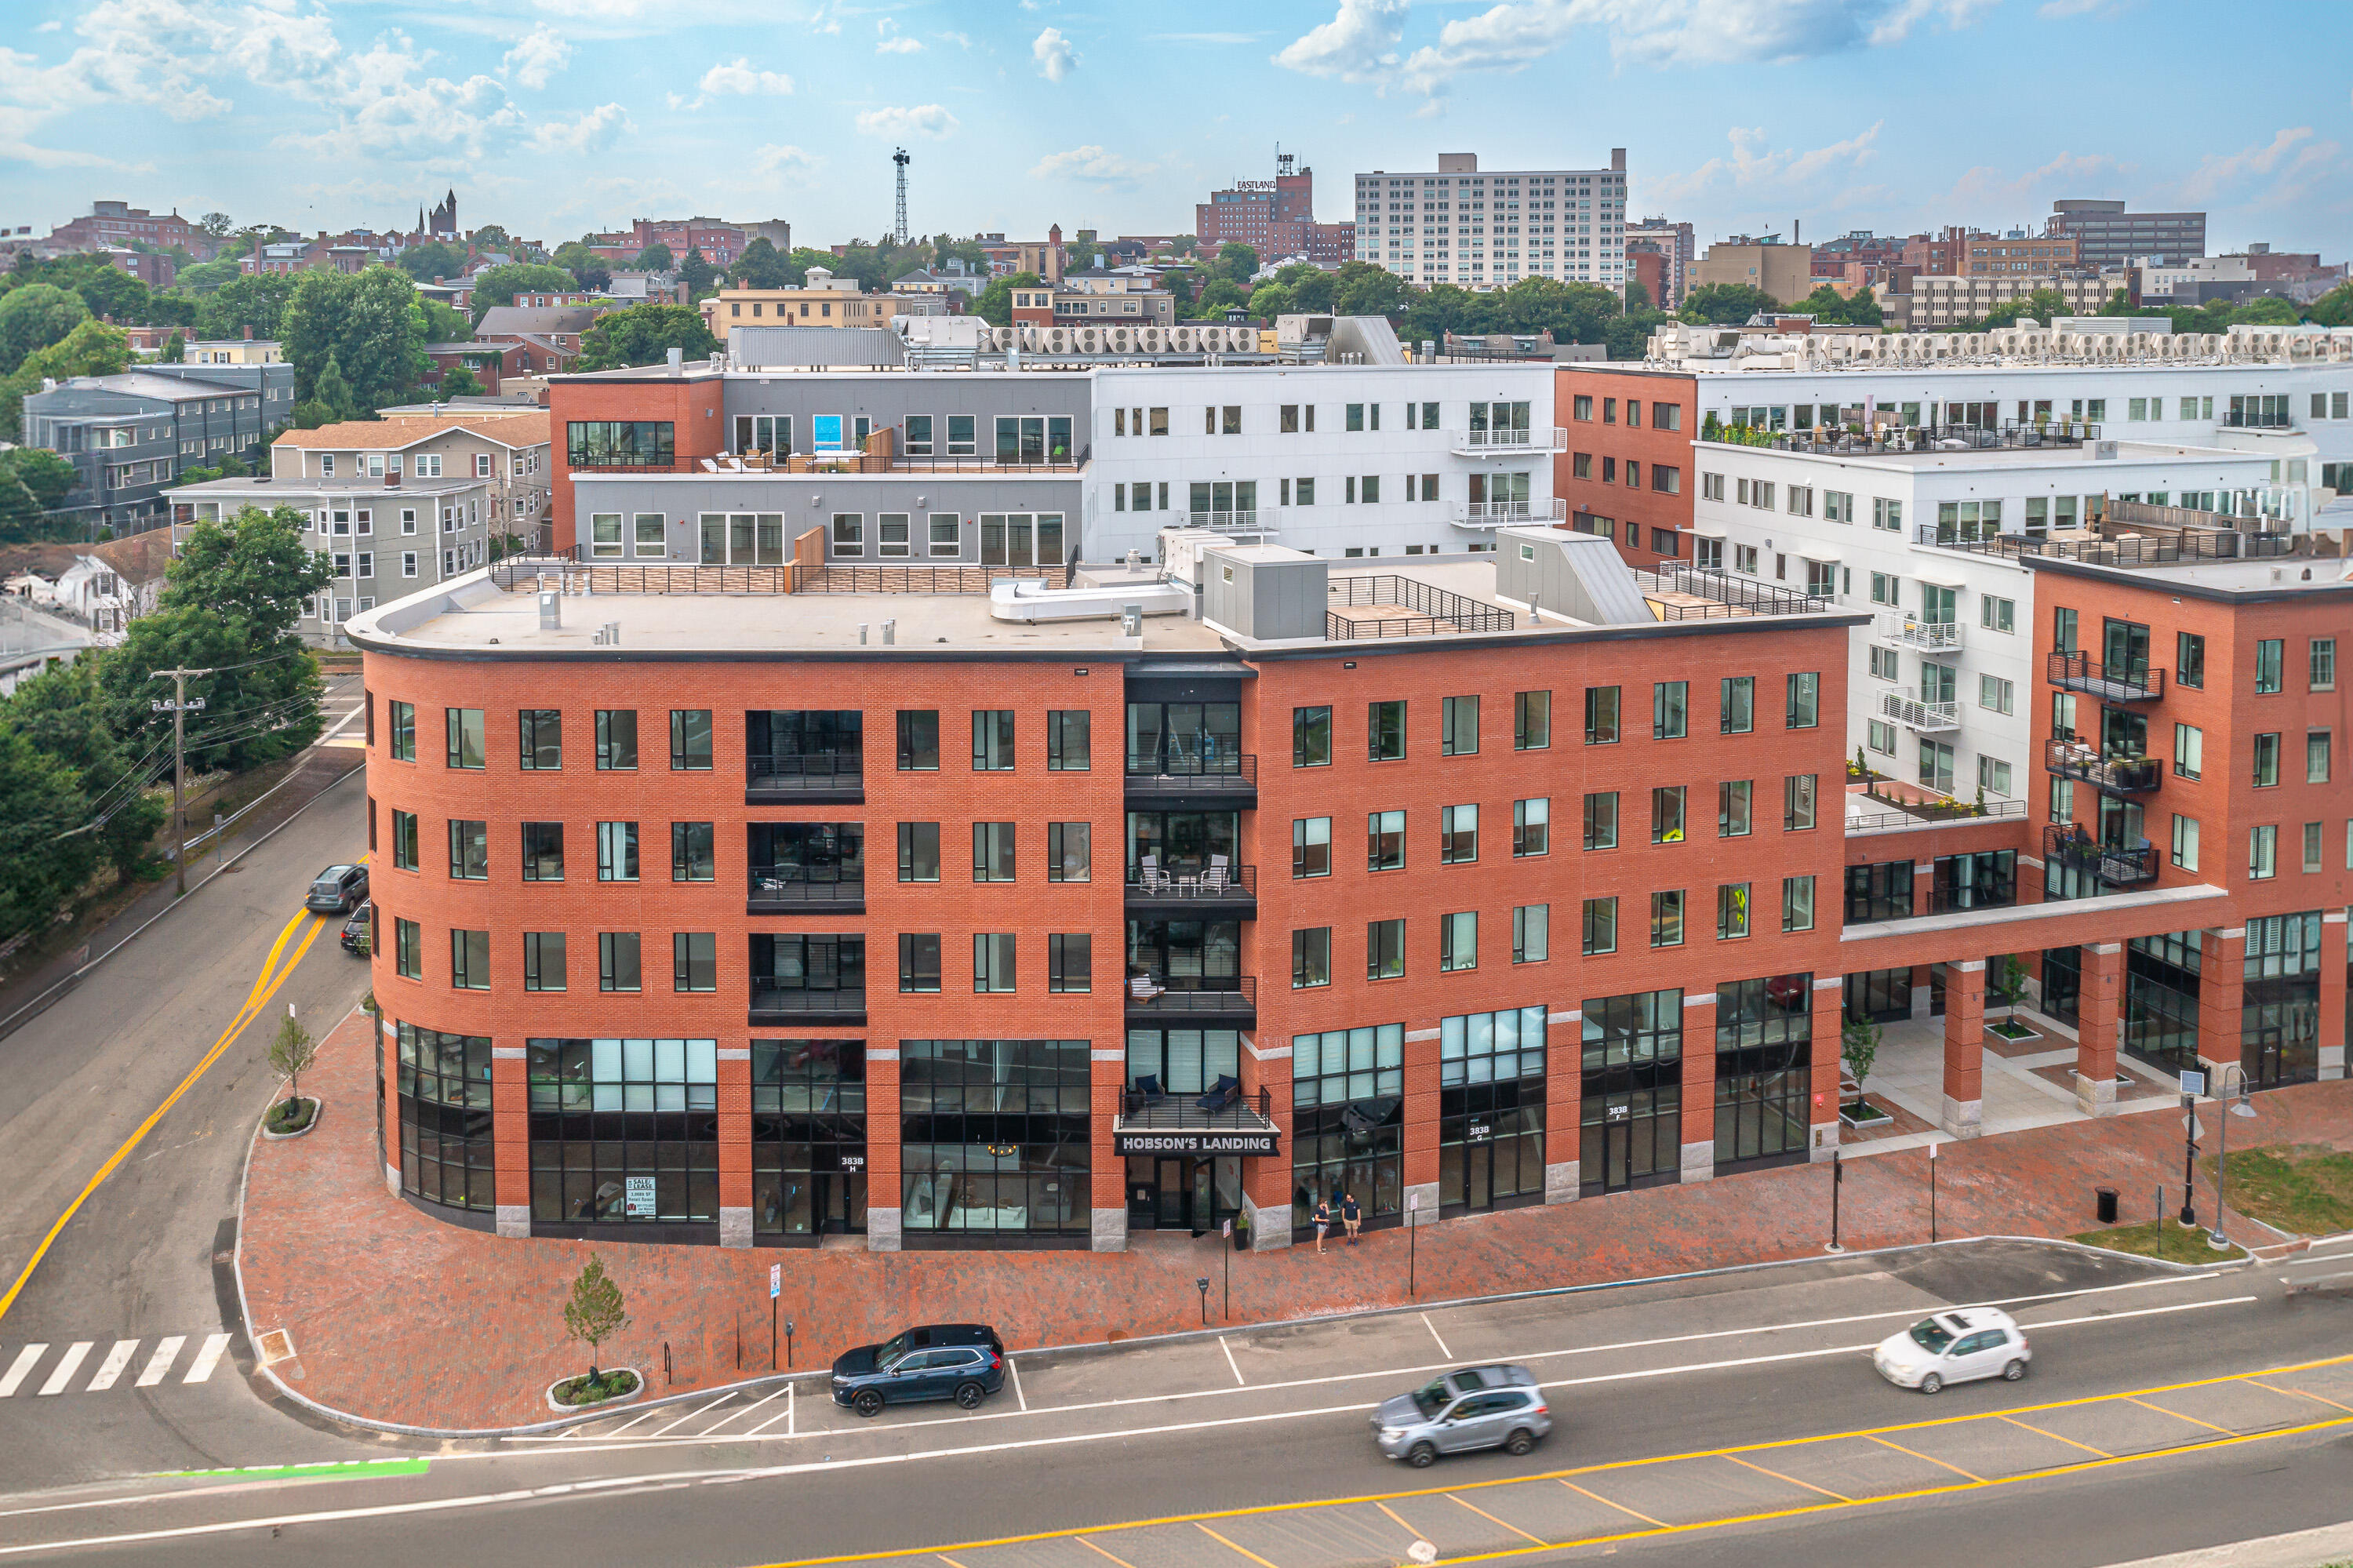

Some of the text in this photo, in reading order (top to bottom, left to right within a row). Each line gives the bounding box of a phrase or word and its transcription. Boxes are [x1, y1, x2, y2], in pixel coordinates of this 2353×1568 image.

[1609, 1105, 1628, 1115] 383B
[1470, 1126, 1489, 1135] 383B
[1123, 1137, 1271, 1150] HOBSON'S LANDING
